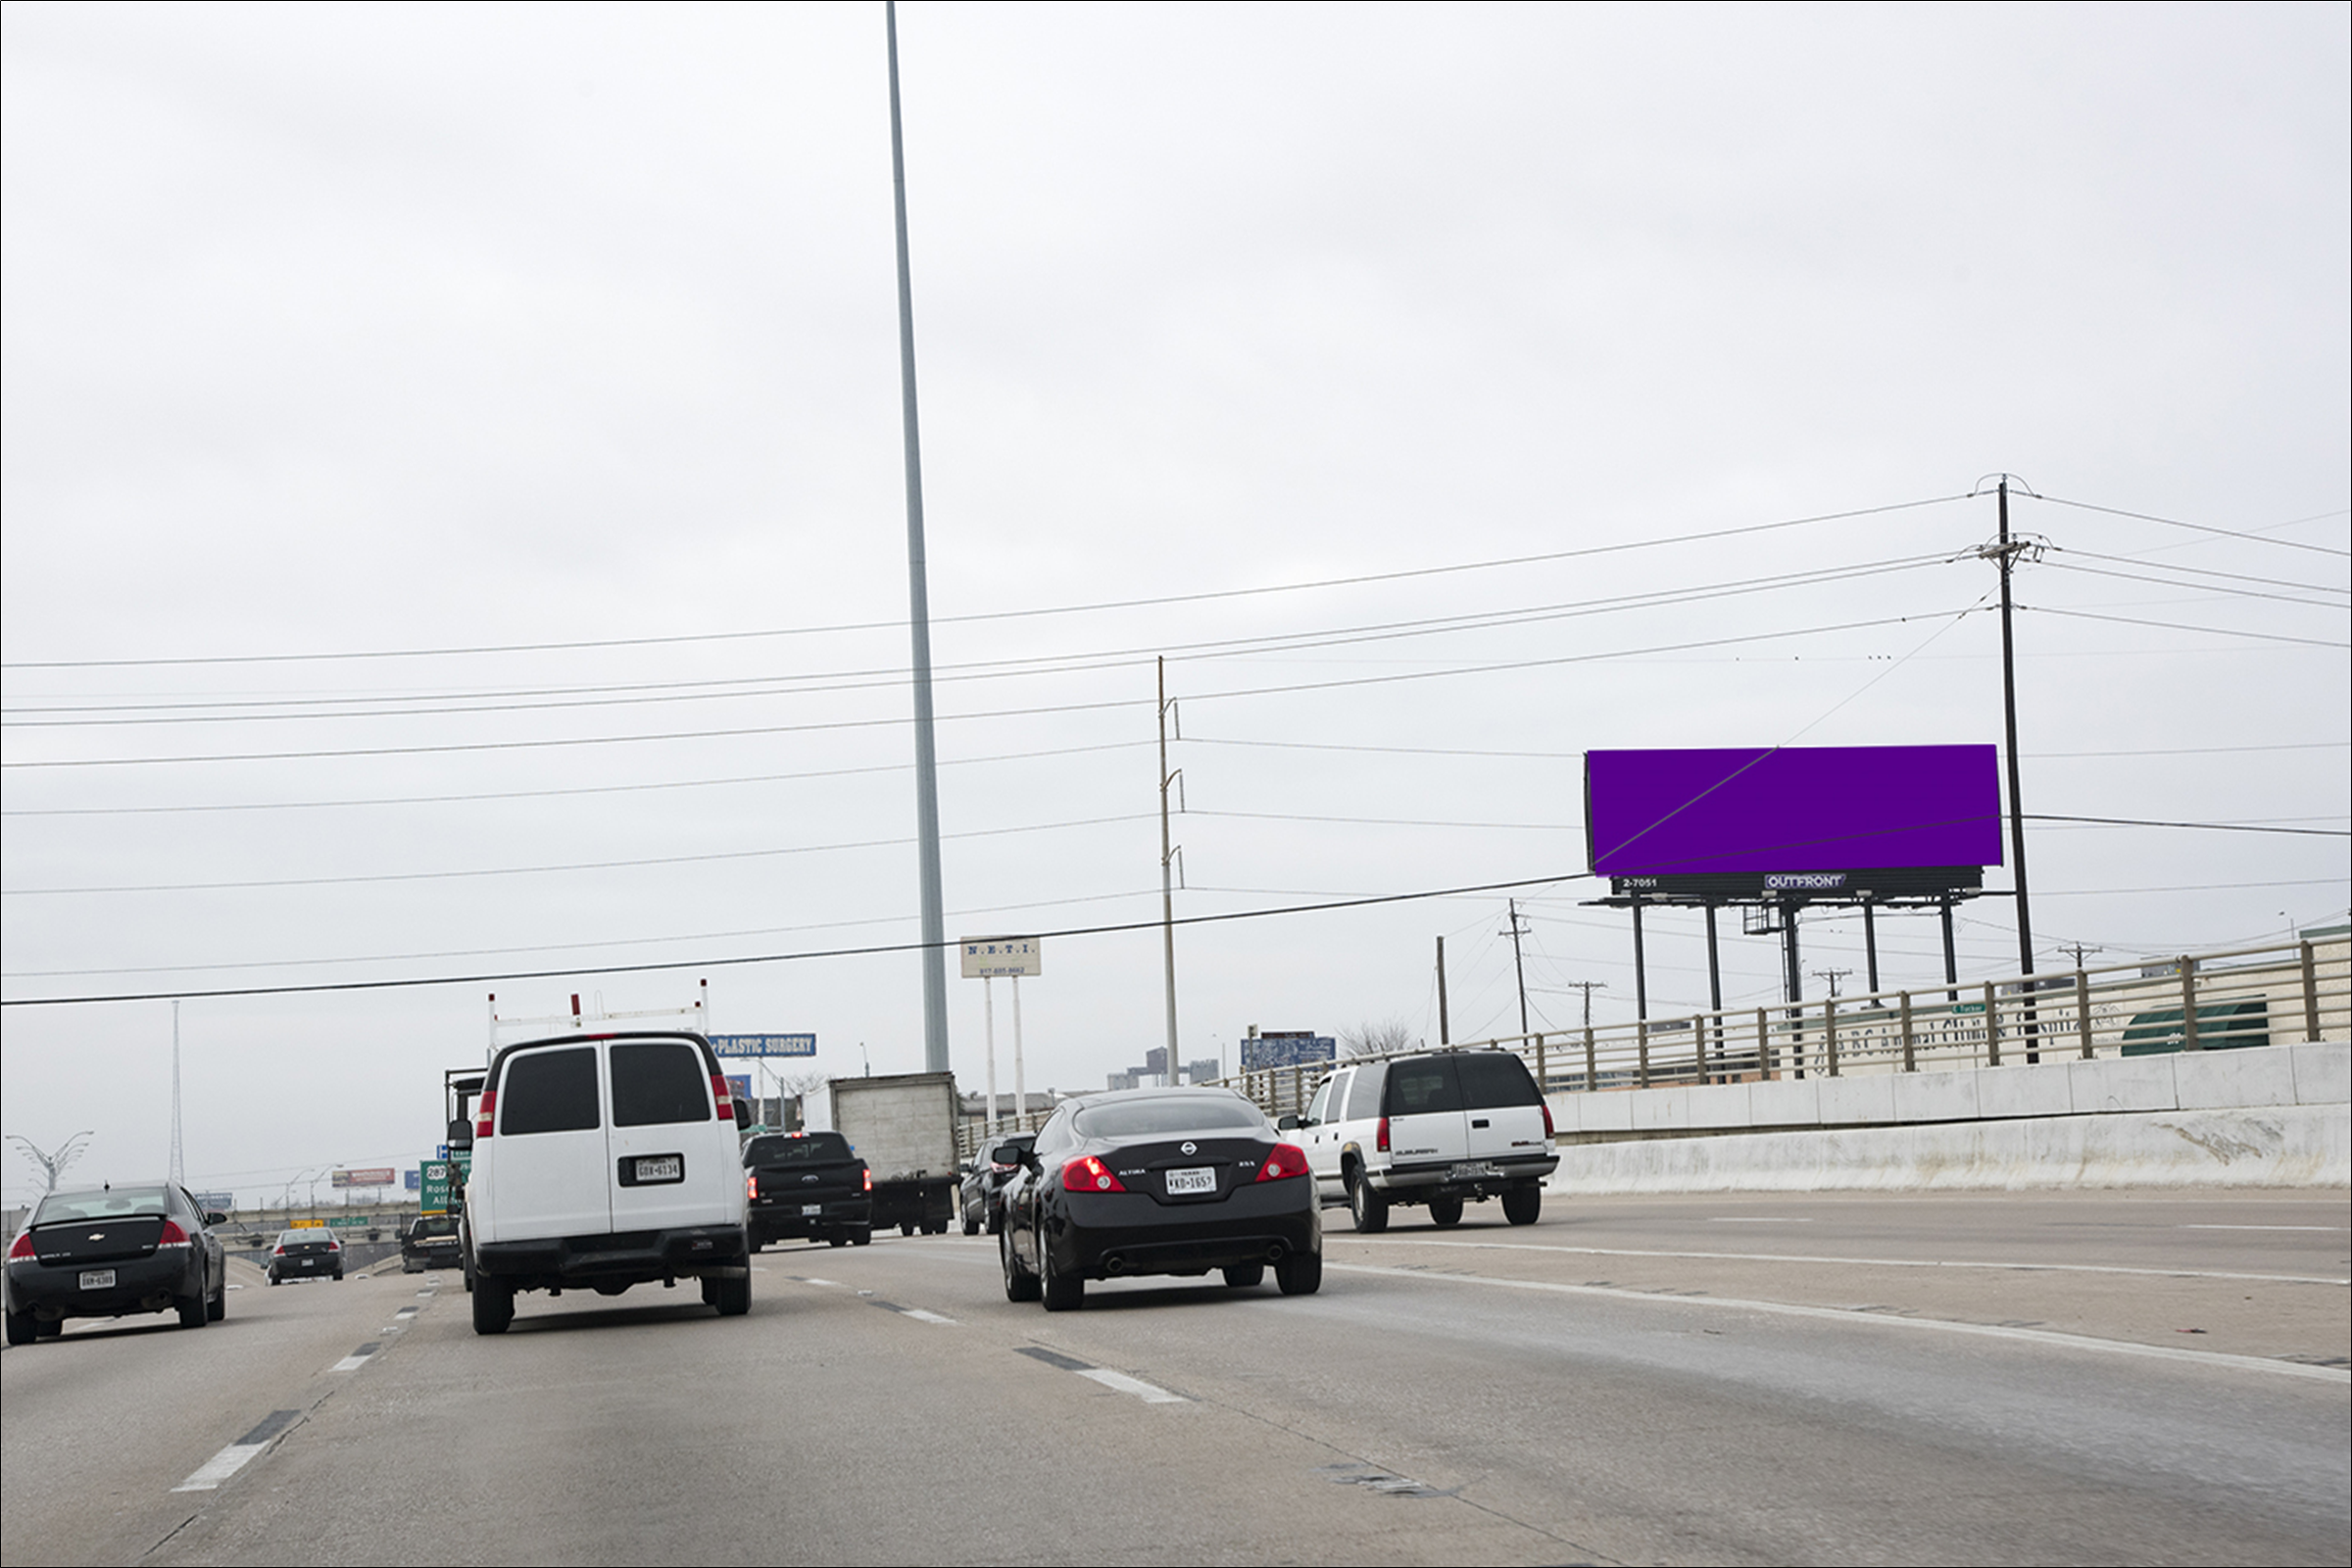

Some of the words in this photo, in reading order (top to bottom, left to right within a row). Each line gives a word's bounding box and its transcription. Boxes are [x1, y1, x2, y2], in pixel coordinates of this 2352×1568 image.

[1623, 878, 1657, 888] 2-7051
[1768, 875, 1842, 888] OUTFRONT
[1880, 1021, 1936, 1055] Anmal
[717, 1038, 762, 1054] PLASTIC
[765, 1037, 812, 1054] SURGERY
[427, 1167, 446, 1178] 287
